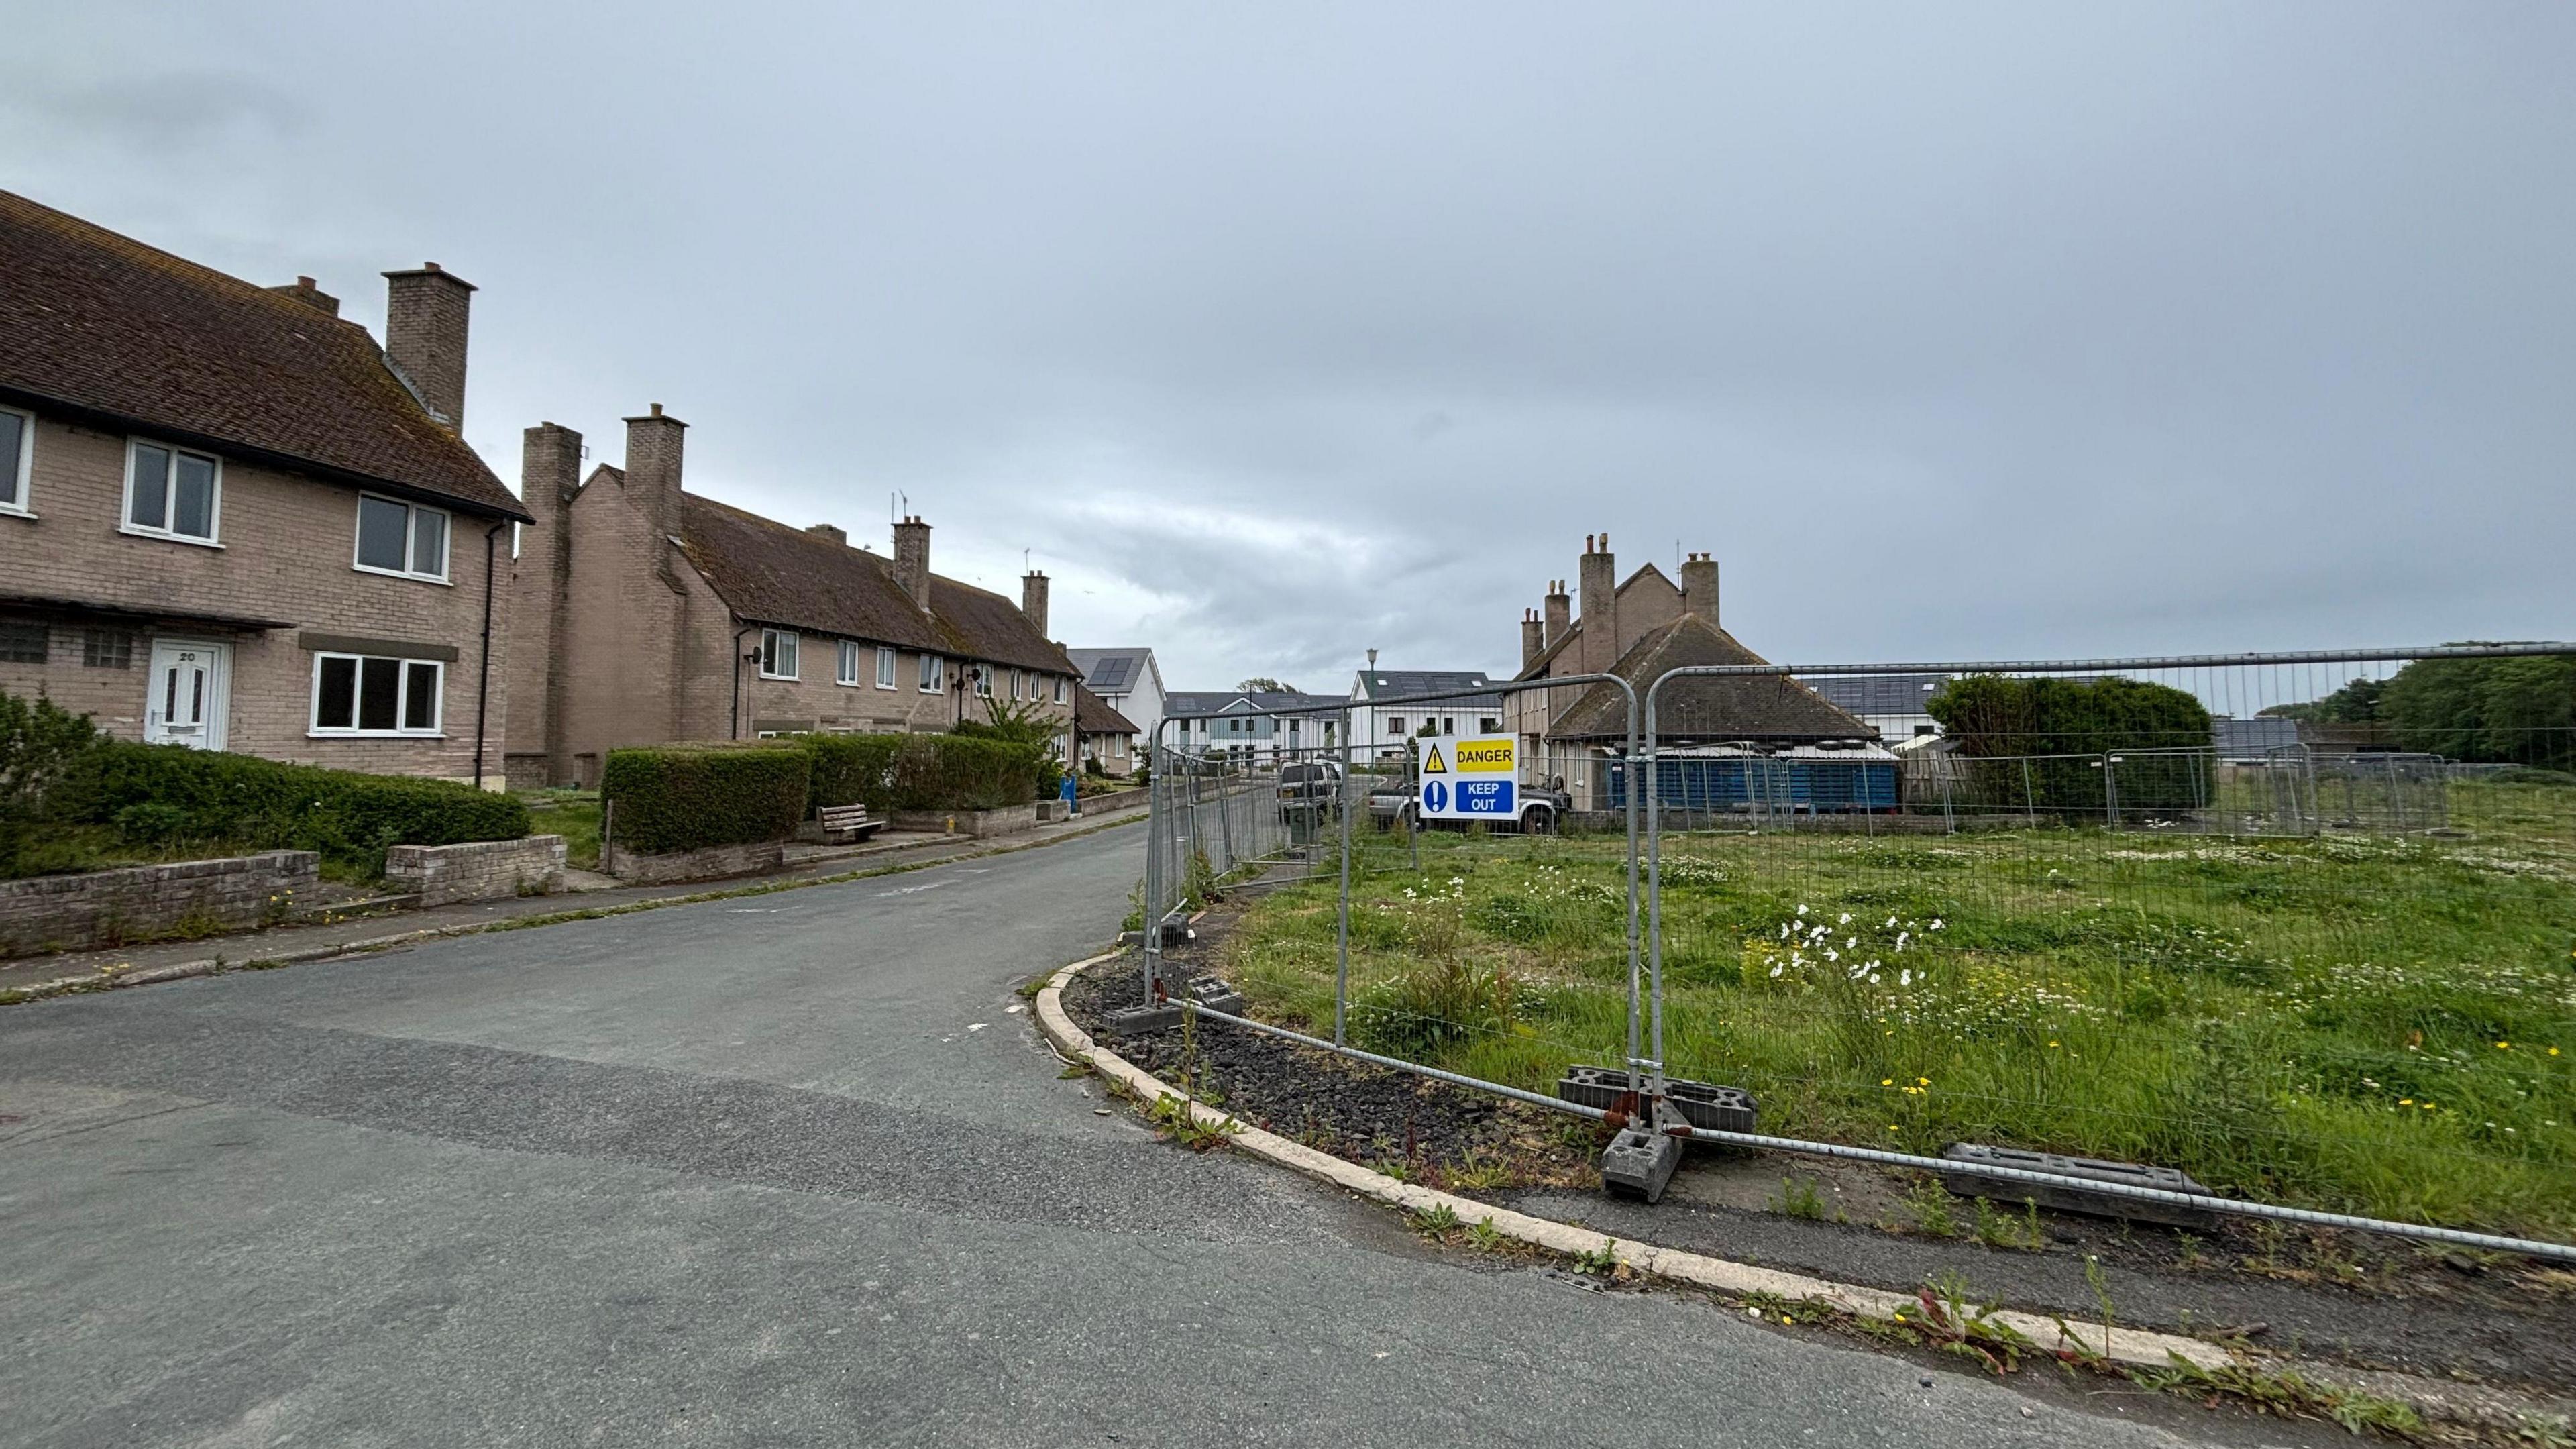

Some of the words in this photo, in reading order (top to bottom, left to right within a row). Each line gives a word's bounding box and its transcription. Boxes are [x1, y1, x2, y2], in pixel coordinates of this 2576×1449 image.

[180, 653, 195, 661] 20
[1457, 749, 1512, 763] DANGER
[1468, 783, 1499, 795] KEEP
[1471, 798, 1496, 810] OUT
